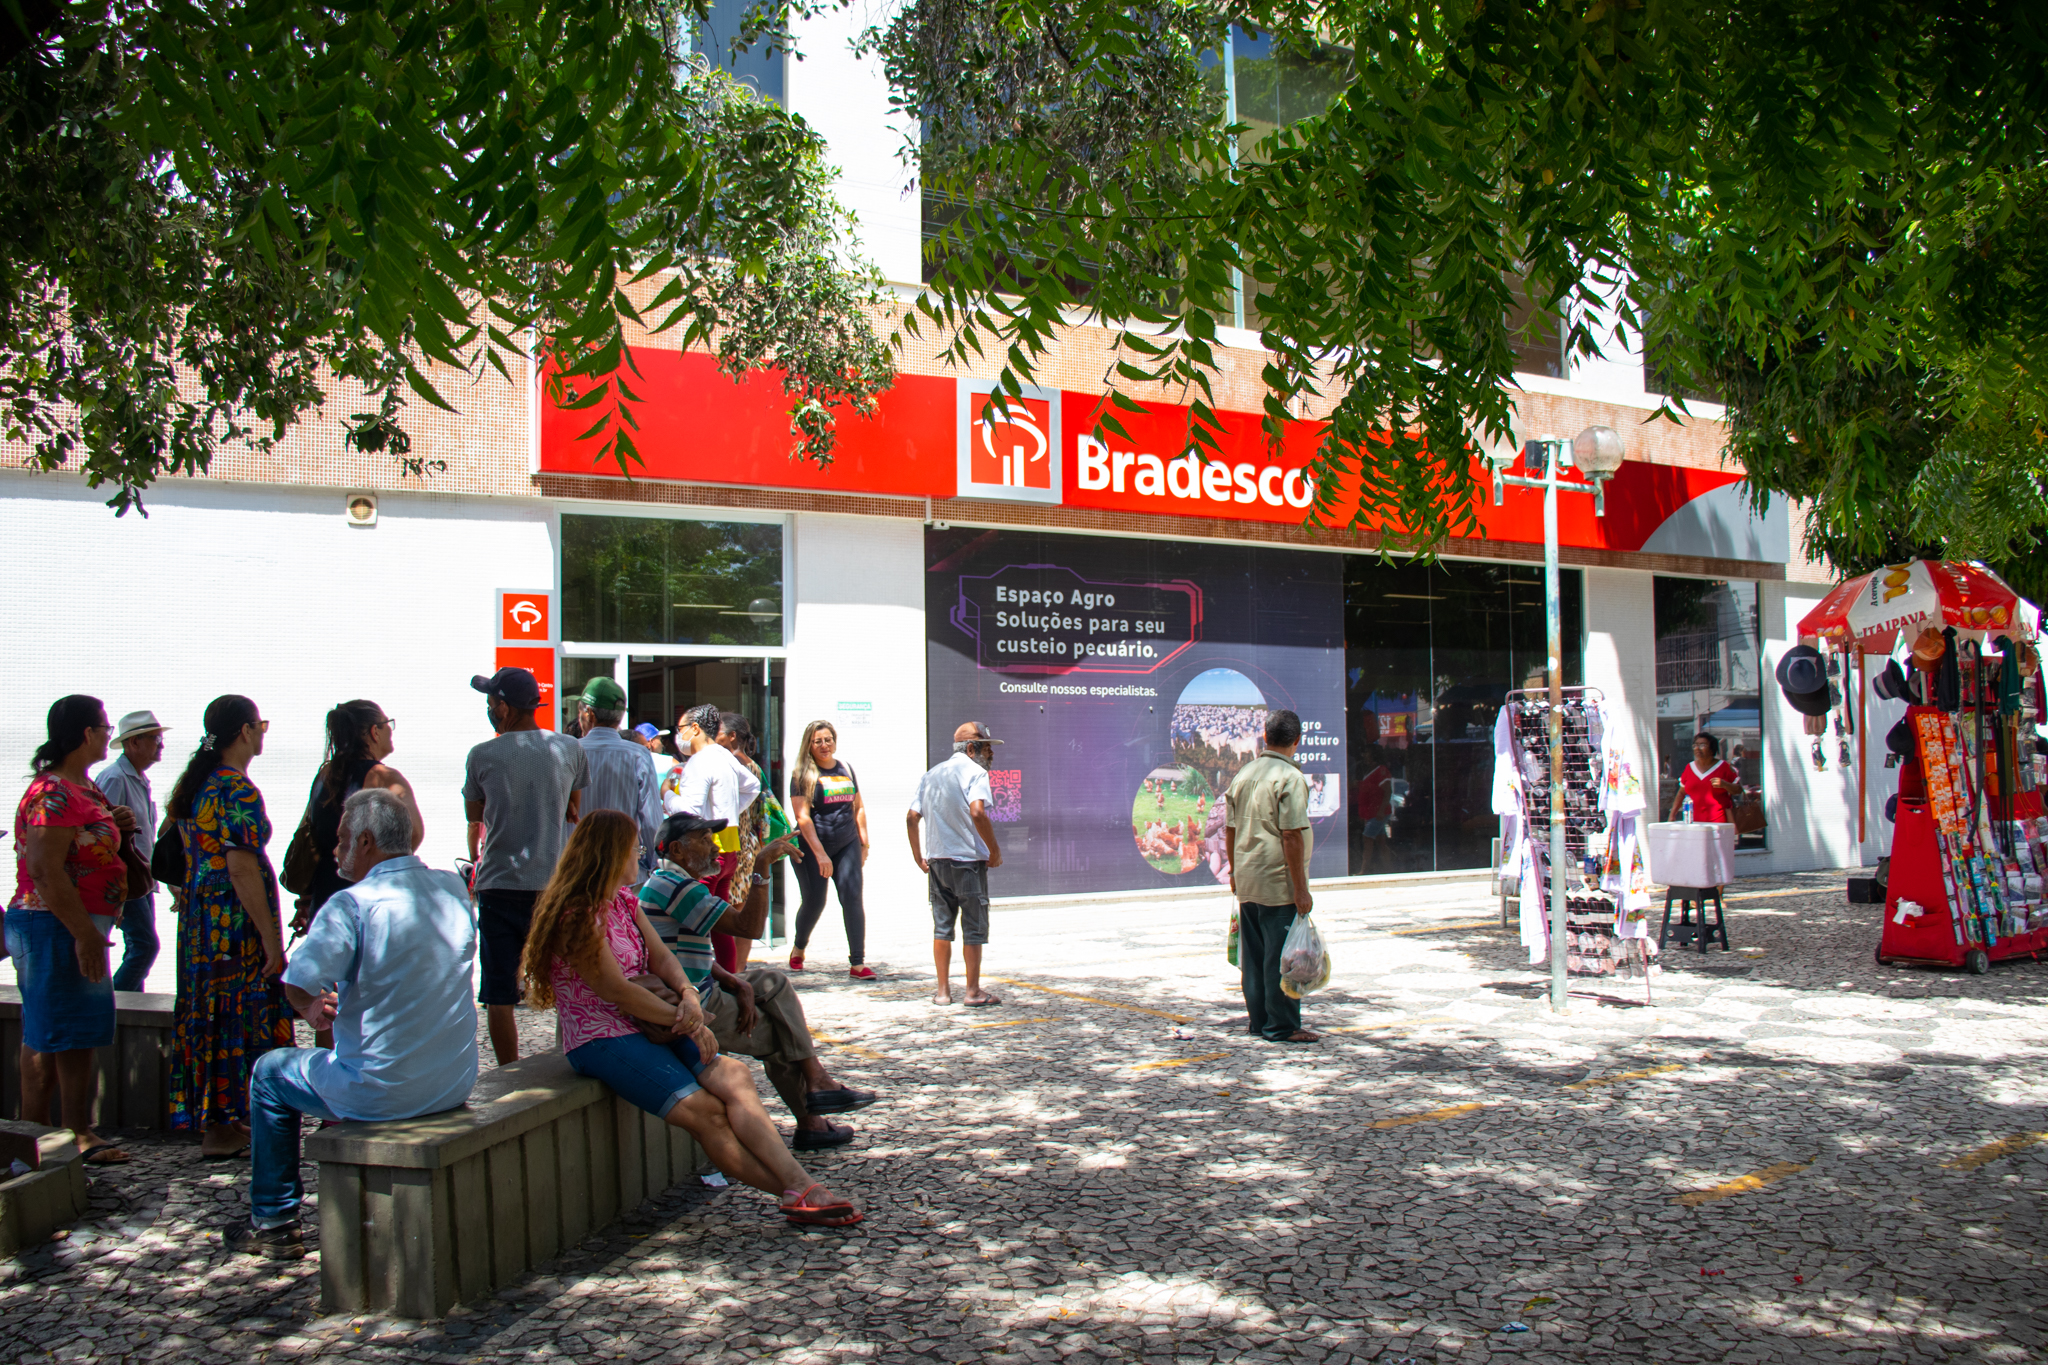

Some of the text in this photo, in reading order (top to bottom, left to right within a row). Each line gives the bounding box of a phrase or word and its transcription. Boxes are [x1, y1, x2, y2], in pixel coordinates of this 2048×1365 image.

[1077, 433, 1315, 508] Bradesco
[996, 586, 1116, 610] Espaço Agro
[996, 611, 1165, 635] Soluções para seu
[1861, 611, 1927, 637] ITAIPAVA
[996, 637, 1158, 659] custeio pecuário.
[999, 681, 1158, 698] Consulte nossos especialistas.
[1301, 721, 1322, 733] gro
[1301, 734, 1340, 746] futuro
[1293, 752, 1331, 764] agora.
[827, 788, 854, 796] AMOUR
[828, 794, 854, 803] AMOUR
